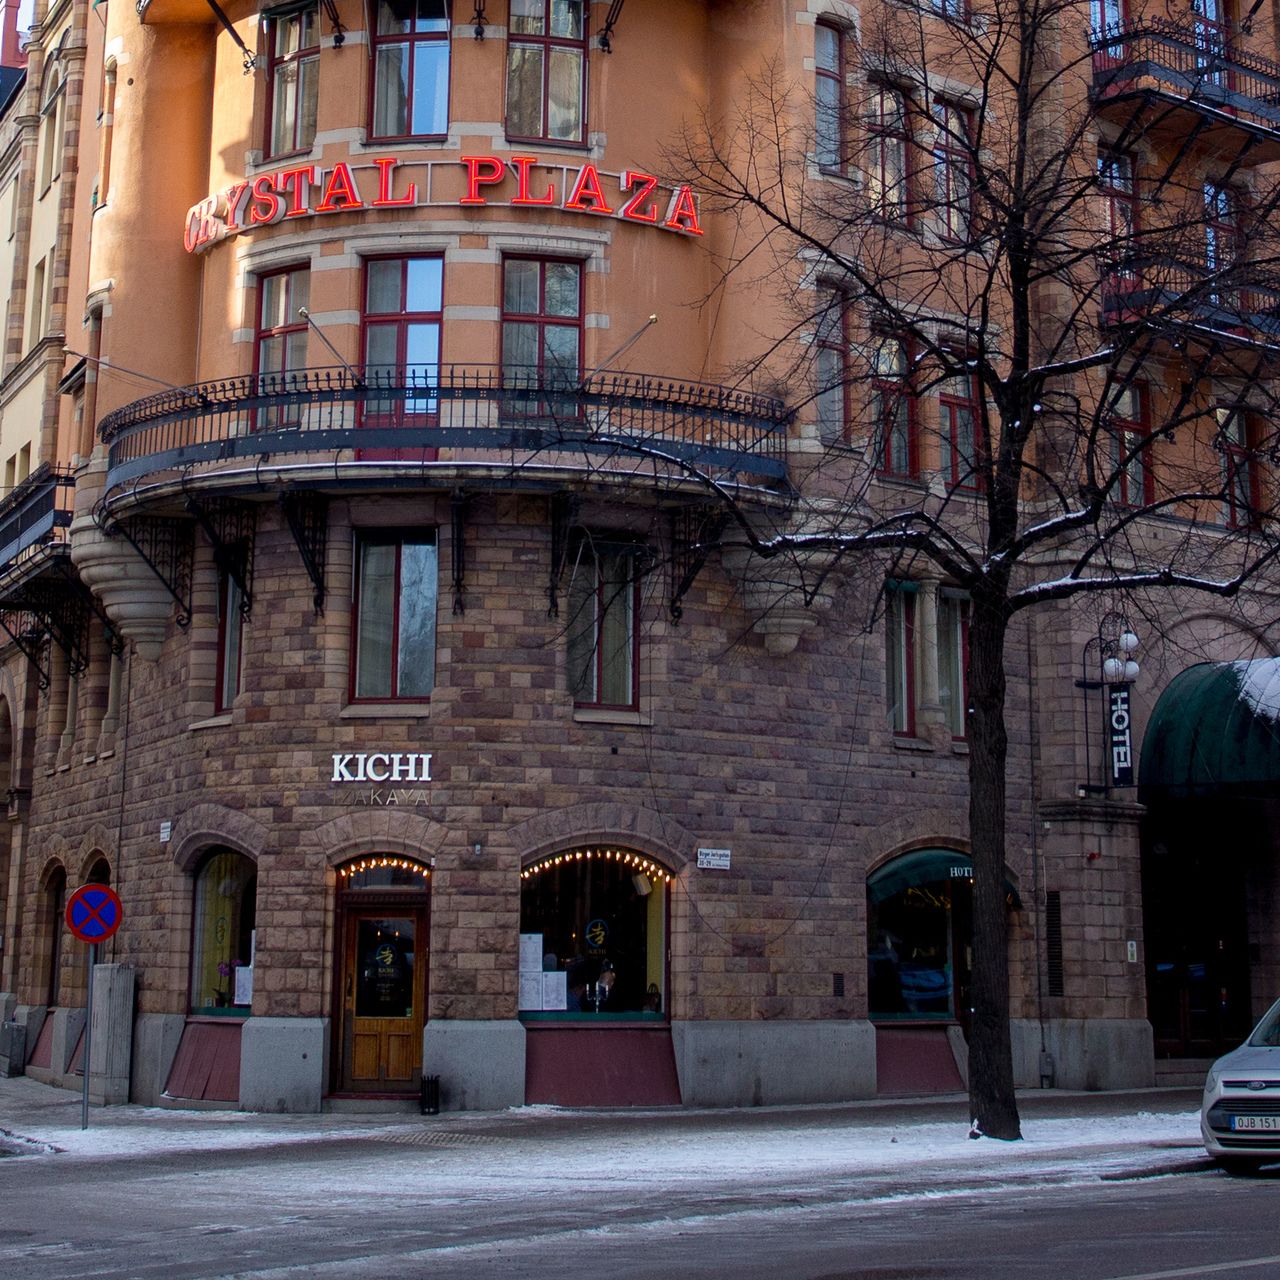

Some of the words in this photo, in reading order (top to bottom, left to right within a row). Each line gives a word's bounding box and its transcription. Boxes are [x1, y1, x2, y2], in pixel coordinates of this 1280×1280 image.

[183, 157, 419, 254] CRYSTAL
[460, 156, 705, 238] PLAZA
[1111, 691, 1131, 778] HOTEL
[331, 753, 432, 781] KICHI
[333, 788, 429, 806] IZAKAYA
[950, 866, 973, 878] HOT
[1238, 1118, 1256, 1128] OJB
[1259, 1118, 1277, 1128] 151
